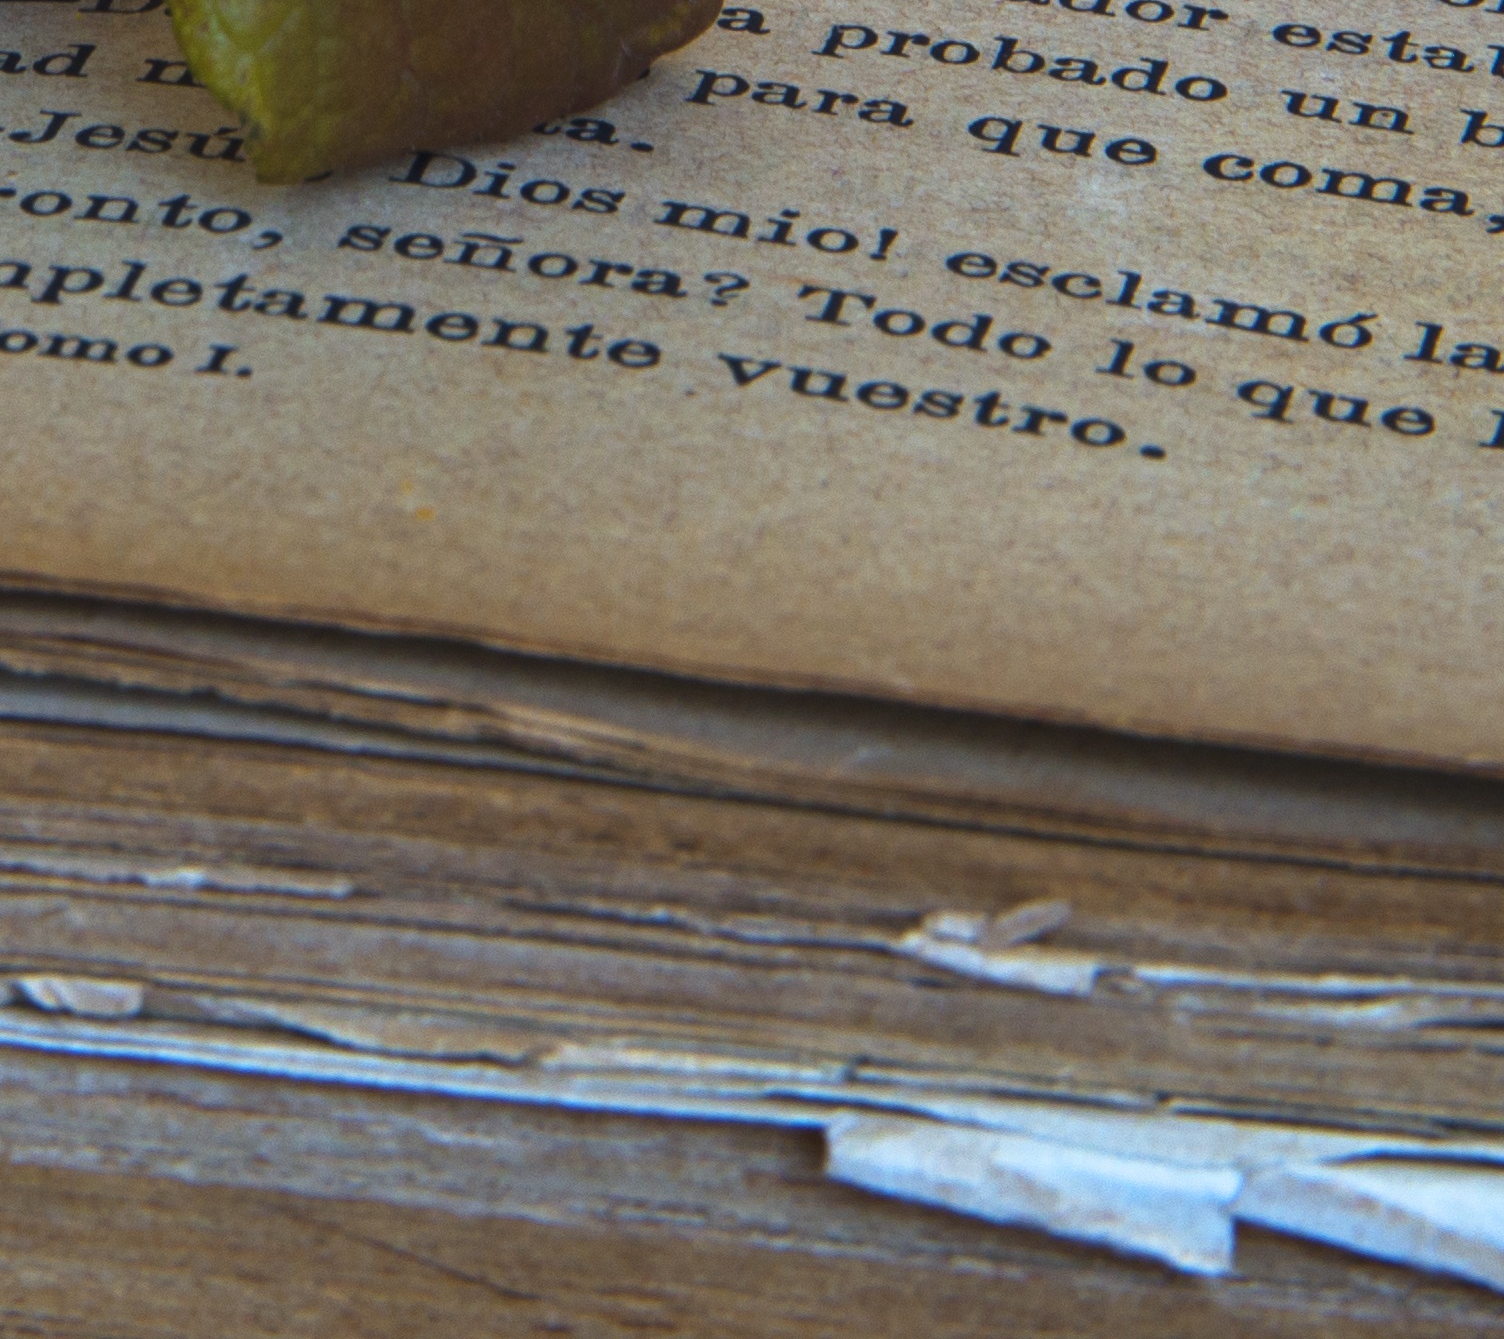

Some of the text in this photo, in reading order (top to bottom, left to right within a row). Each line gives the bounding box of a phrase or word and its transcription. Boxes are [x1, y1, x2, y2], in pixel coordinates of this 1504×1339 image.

[685, 70, 914, 128] para
[967, 116, 1157, 166] que
[813, 24, 1227, 102] probado
[1282, 90, 1413, 135] un
[387, 149, 626, 216] Dios
[654, 200, 898, 261] mio!
[945, 252, 1376, 349] esclamó
[197, 345, 252, 378] I.
[337, 224, 750, 307] señora?
[798, 284, 1051, 359] Todo
[1098, 339, 1196, 387] lo
[1236, 380, 1435, 436] que
[718, 353, 1166, 460] vuestro.
